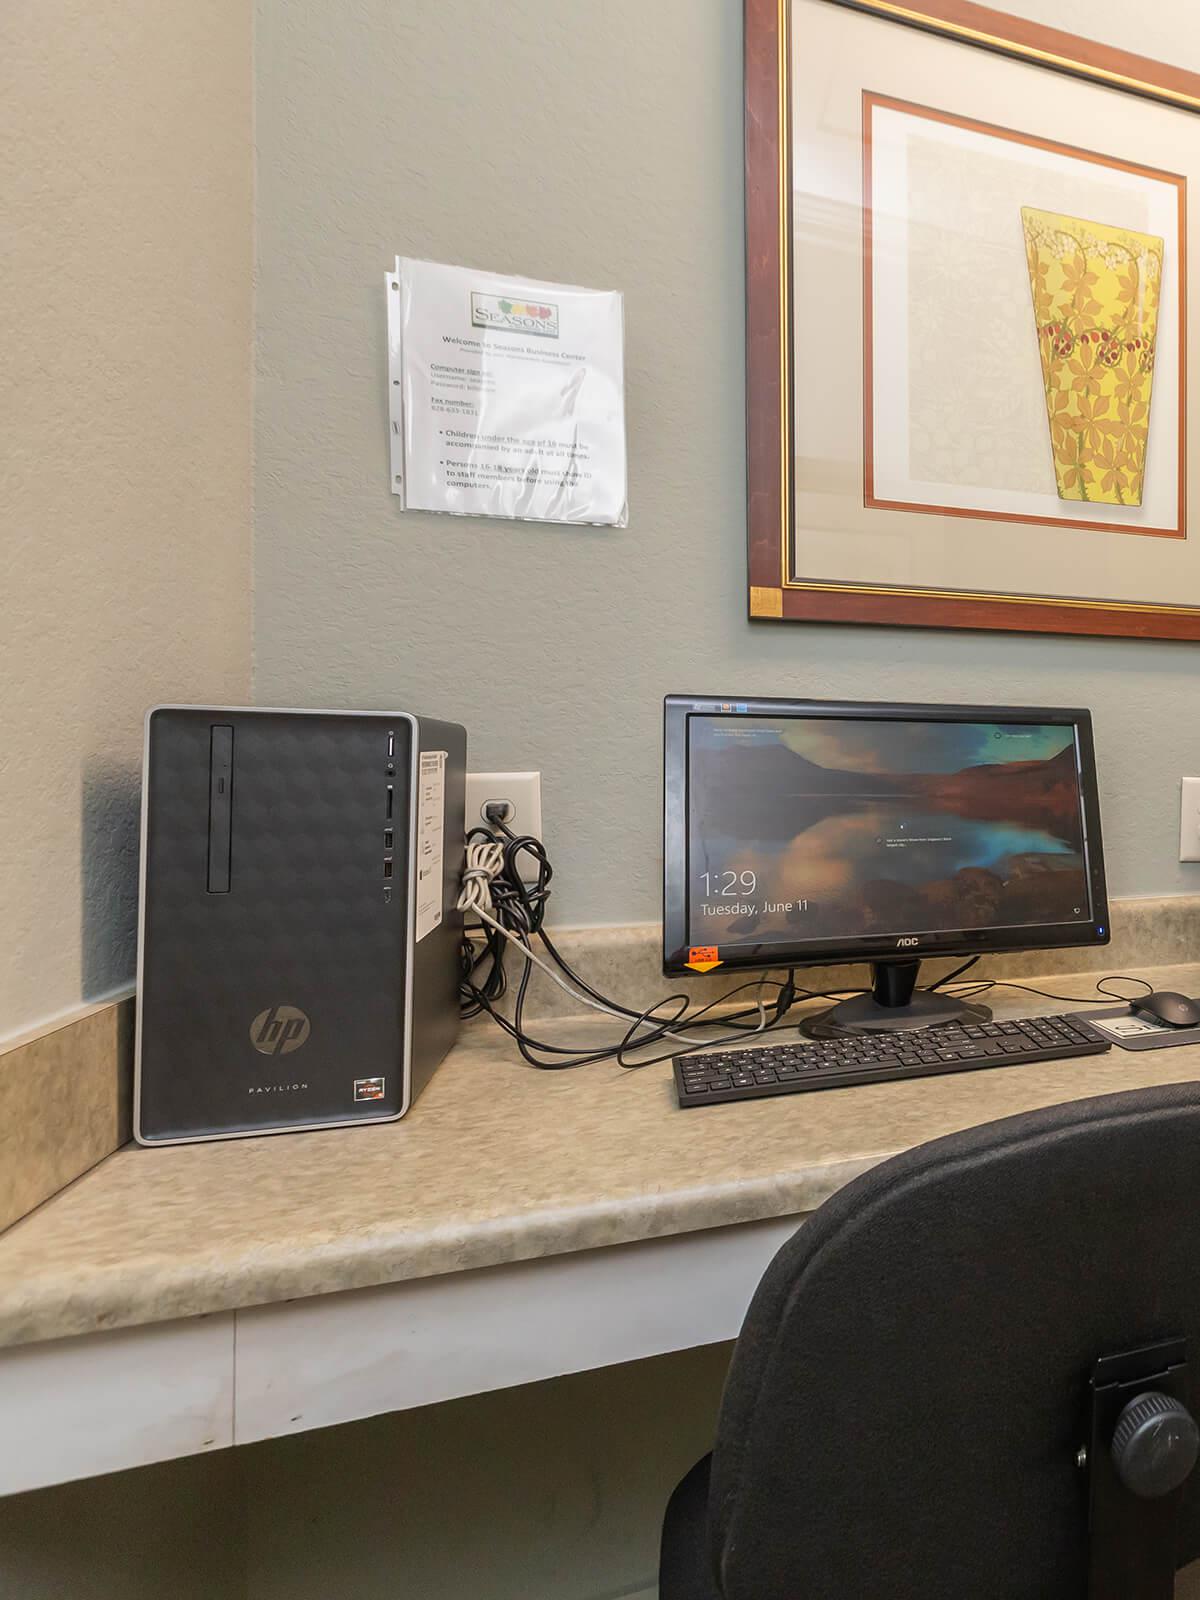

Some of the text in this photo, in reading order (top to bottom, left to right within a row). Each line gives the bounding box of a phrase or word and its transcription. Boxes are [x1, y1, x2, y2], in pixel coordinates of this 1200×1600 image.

[442, 335, 481, 347] Welcome
[699, 870, 757, 897] 1:29
[700, 899, 808, 917] Tuesday, June 11
[896, 937, 919, 948] AOC
[250, 1006, 310, 1055] hp
[248, 1083, 308, 1094] PAVILION
